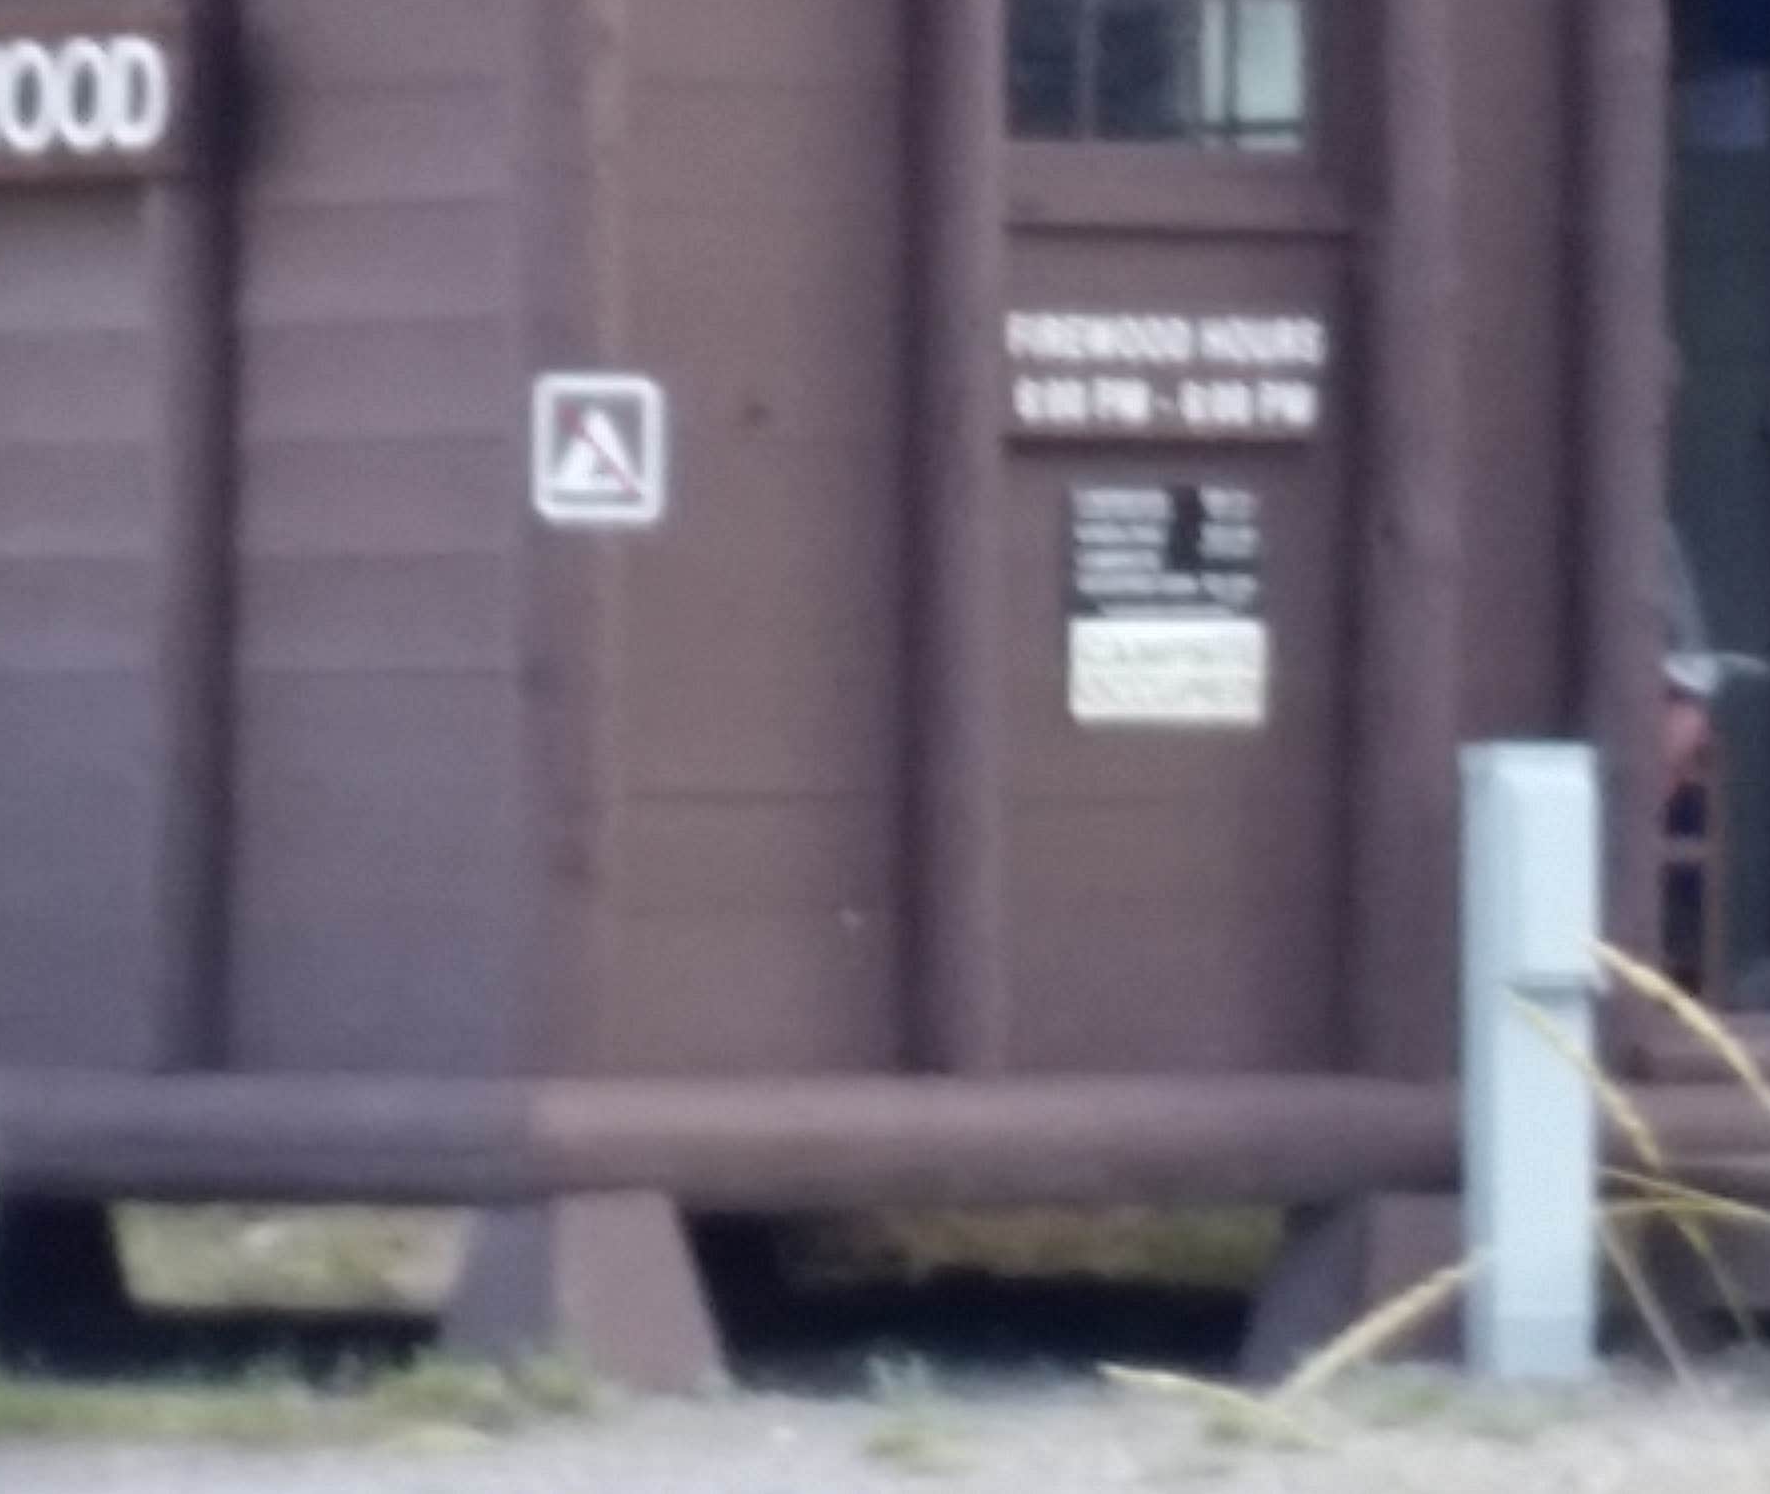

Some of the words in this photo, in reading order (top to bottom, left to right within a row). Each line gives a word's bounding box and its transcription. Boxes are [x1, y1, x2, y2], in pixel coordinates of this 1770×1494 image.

[1004, 311, 1192, 363] FIREWOOD
[1198, 315, 1325, 367] HOURS
[1091, 375, 1151, 428] PM
[1257, 377, 1318, 430] PM
